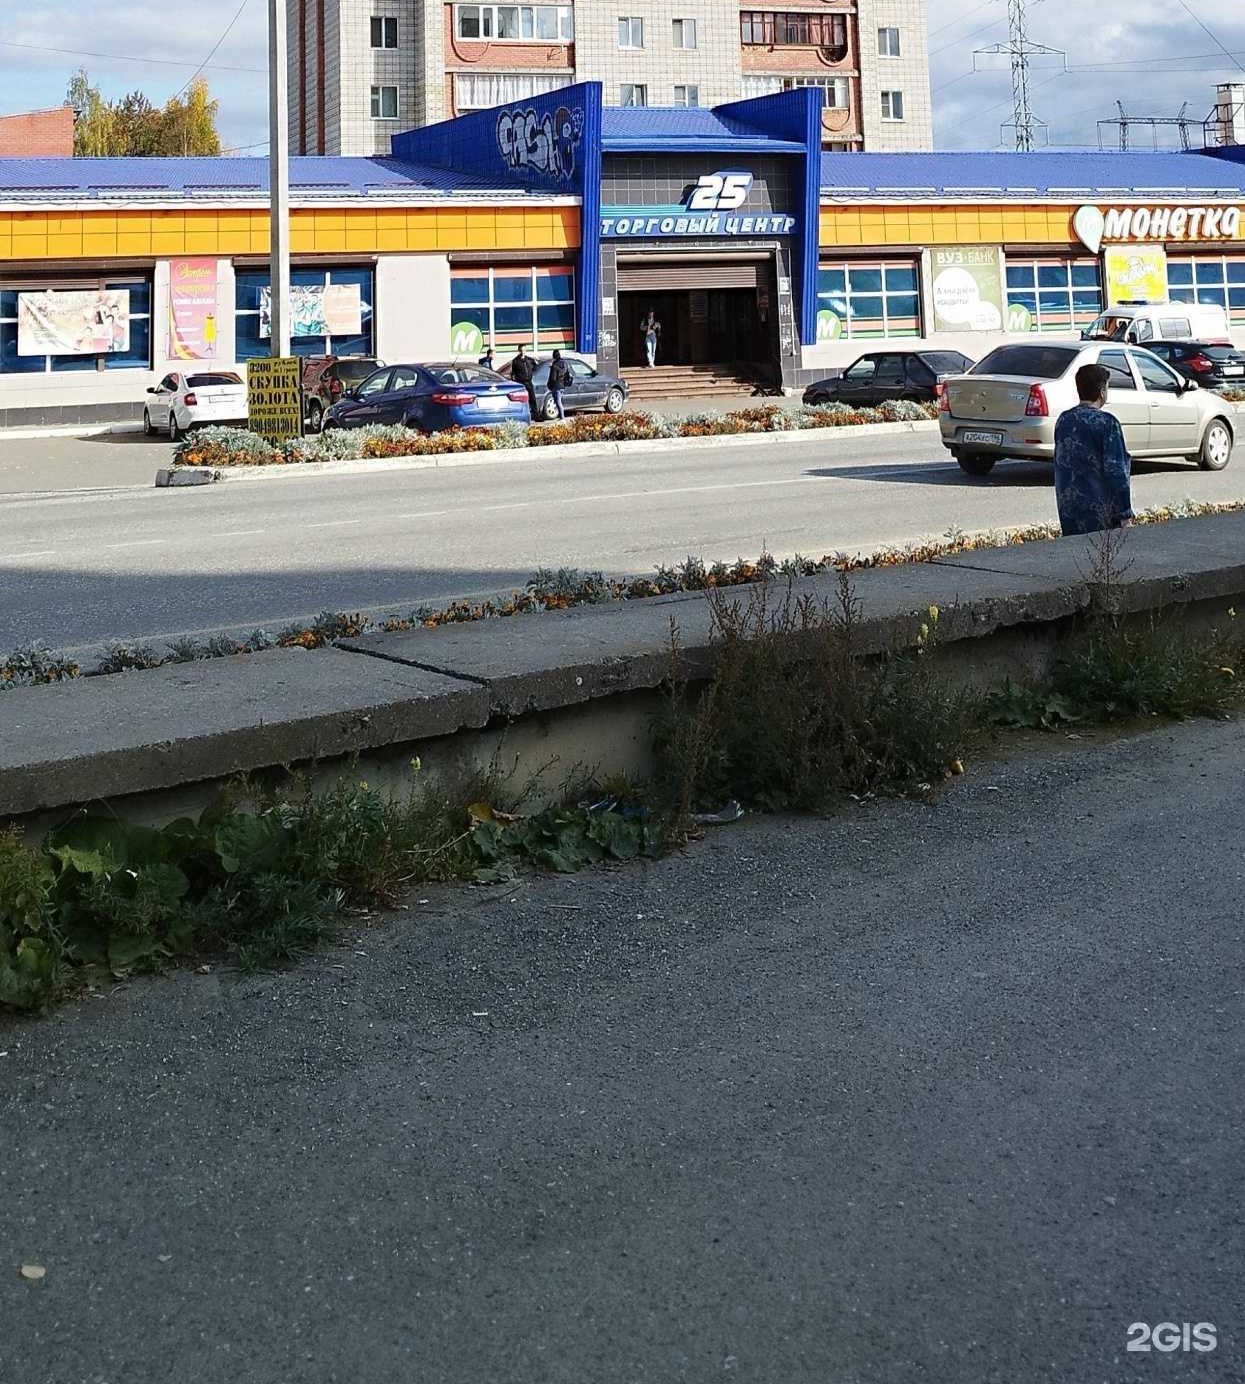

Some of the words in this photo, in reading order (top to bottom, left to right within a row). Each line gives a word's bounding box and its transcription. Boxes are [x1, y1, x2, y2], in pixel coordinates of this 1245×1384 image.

[688, 175, 753, 211] 25
[601, 213, 719, 235] ТОРГОВЫЙ
[725, 217, 796, 236] ЦЕНТР
[249, 376, 297, 389] СКУПКА
[249, 392, 297, 405] ЗОЛОТА
